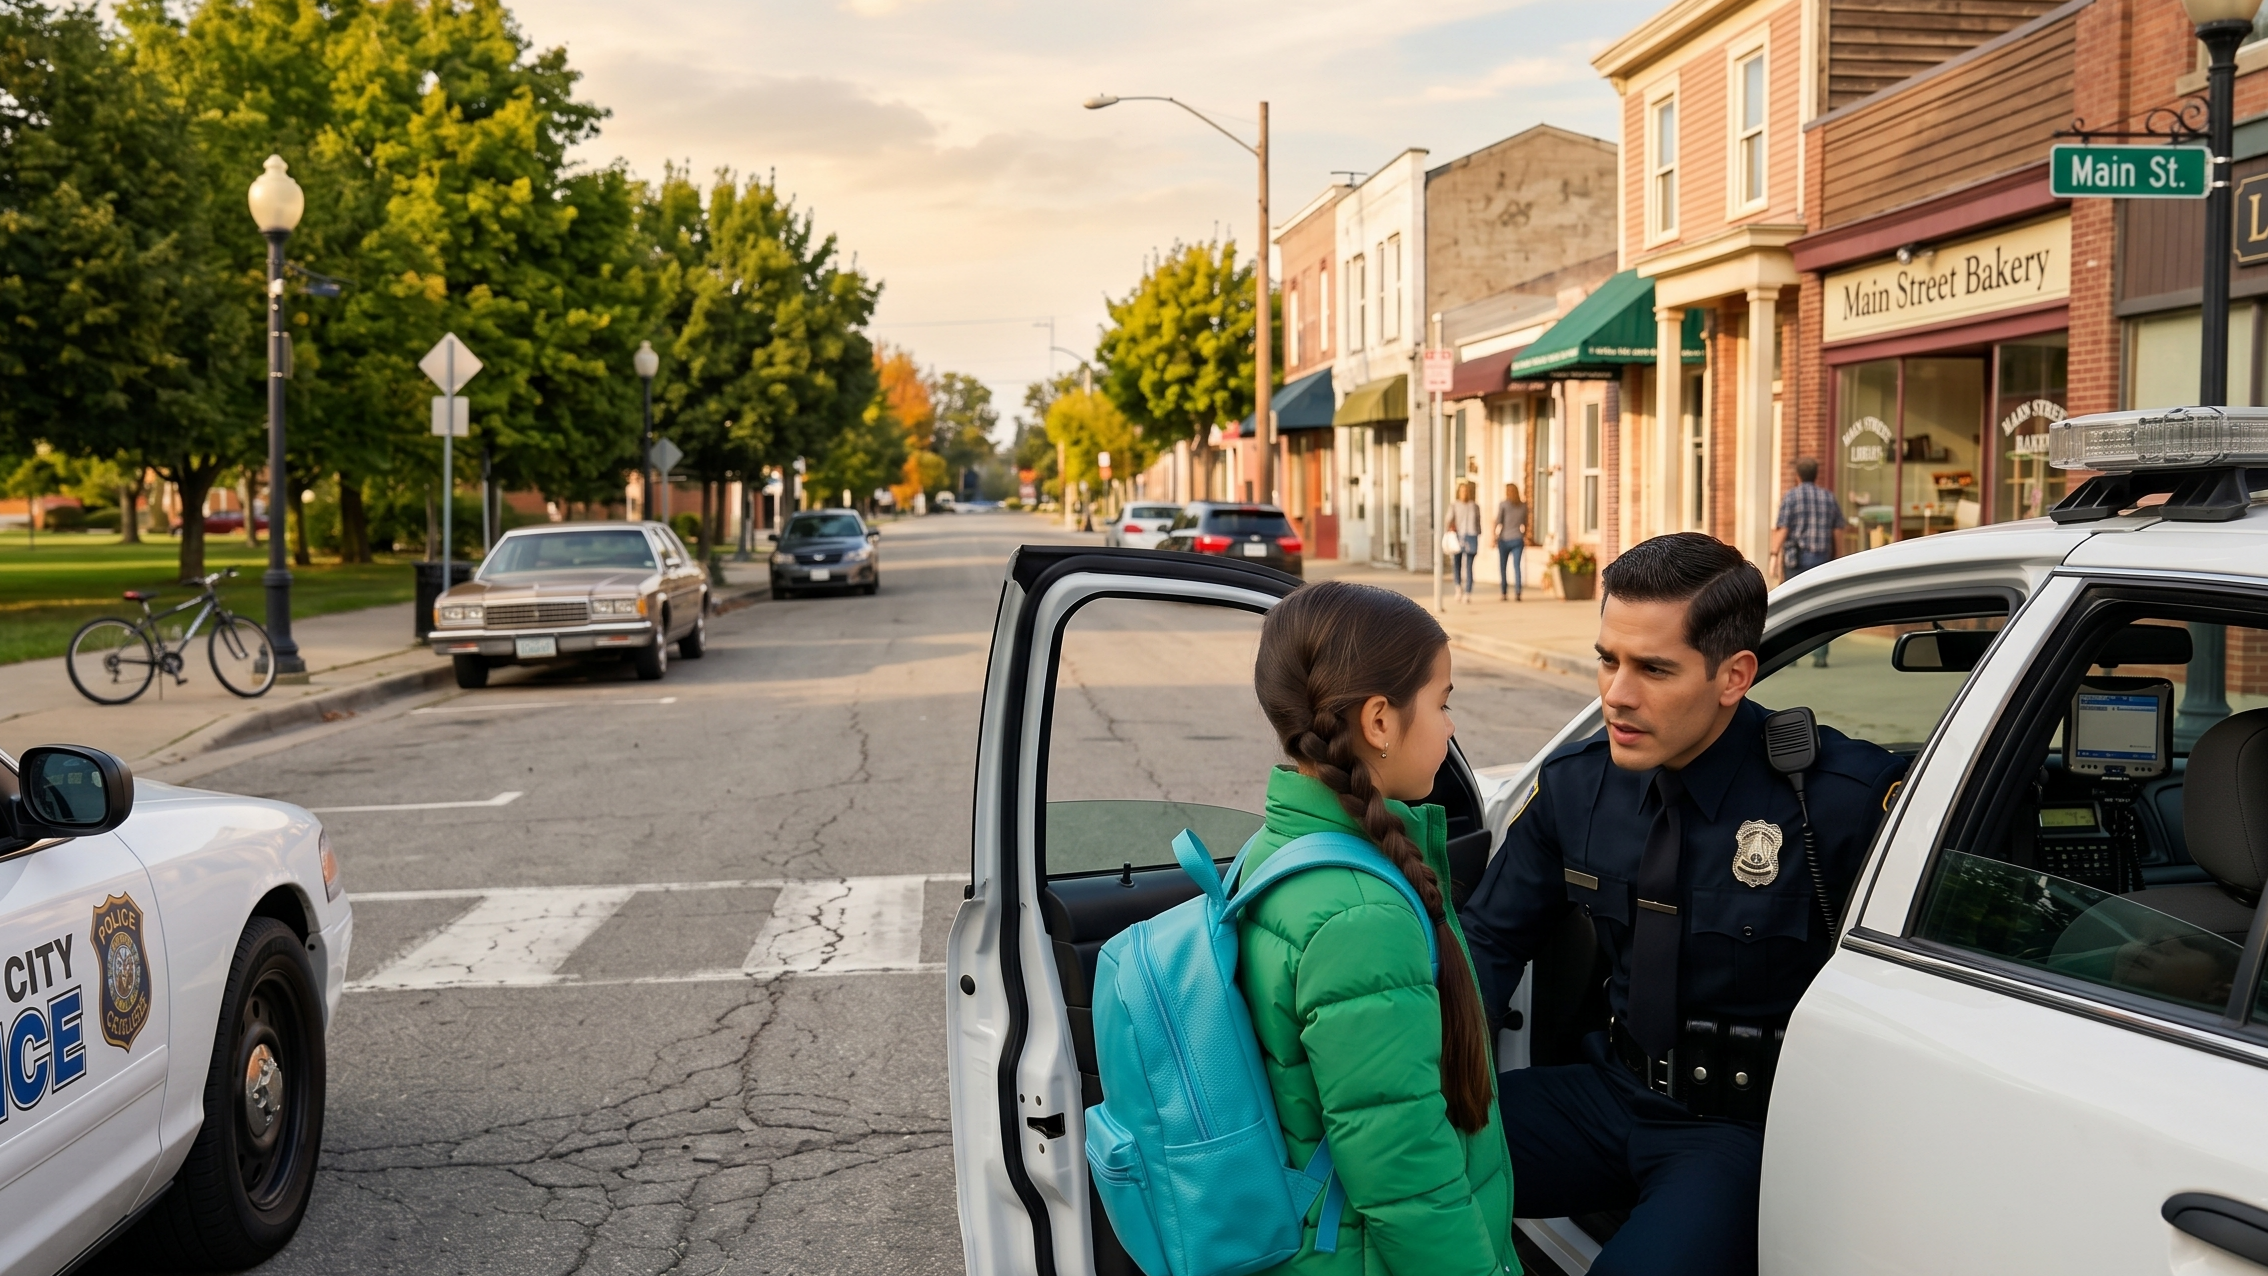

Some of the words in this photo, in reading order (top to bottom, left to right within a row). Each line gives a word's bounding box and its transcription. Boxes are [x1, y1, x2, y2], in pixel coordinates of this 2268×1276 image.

[2071, 154, 2136, 188] Main
[2149, 154, 2186, 189] St.
[1842, 279, 1890, 321] Main
[1895, 266, 1957, 310] Street
[1964, 245, 2051, 295] Bakery
[98, 908, 136, 946] POLICE
[4, 932, 73, 1003] CITY
